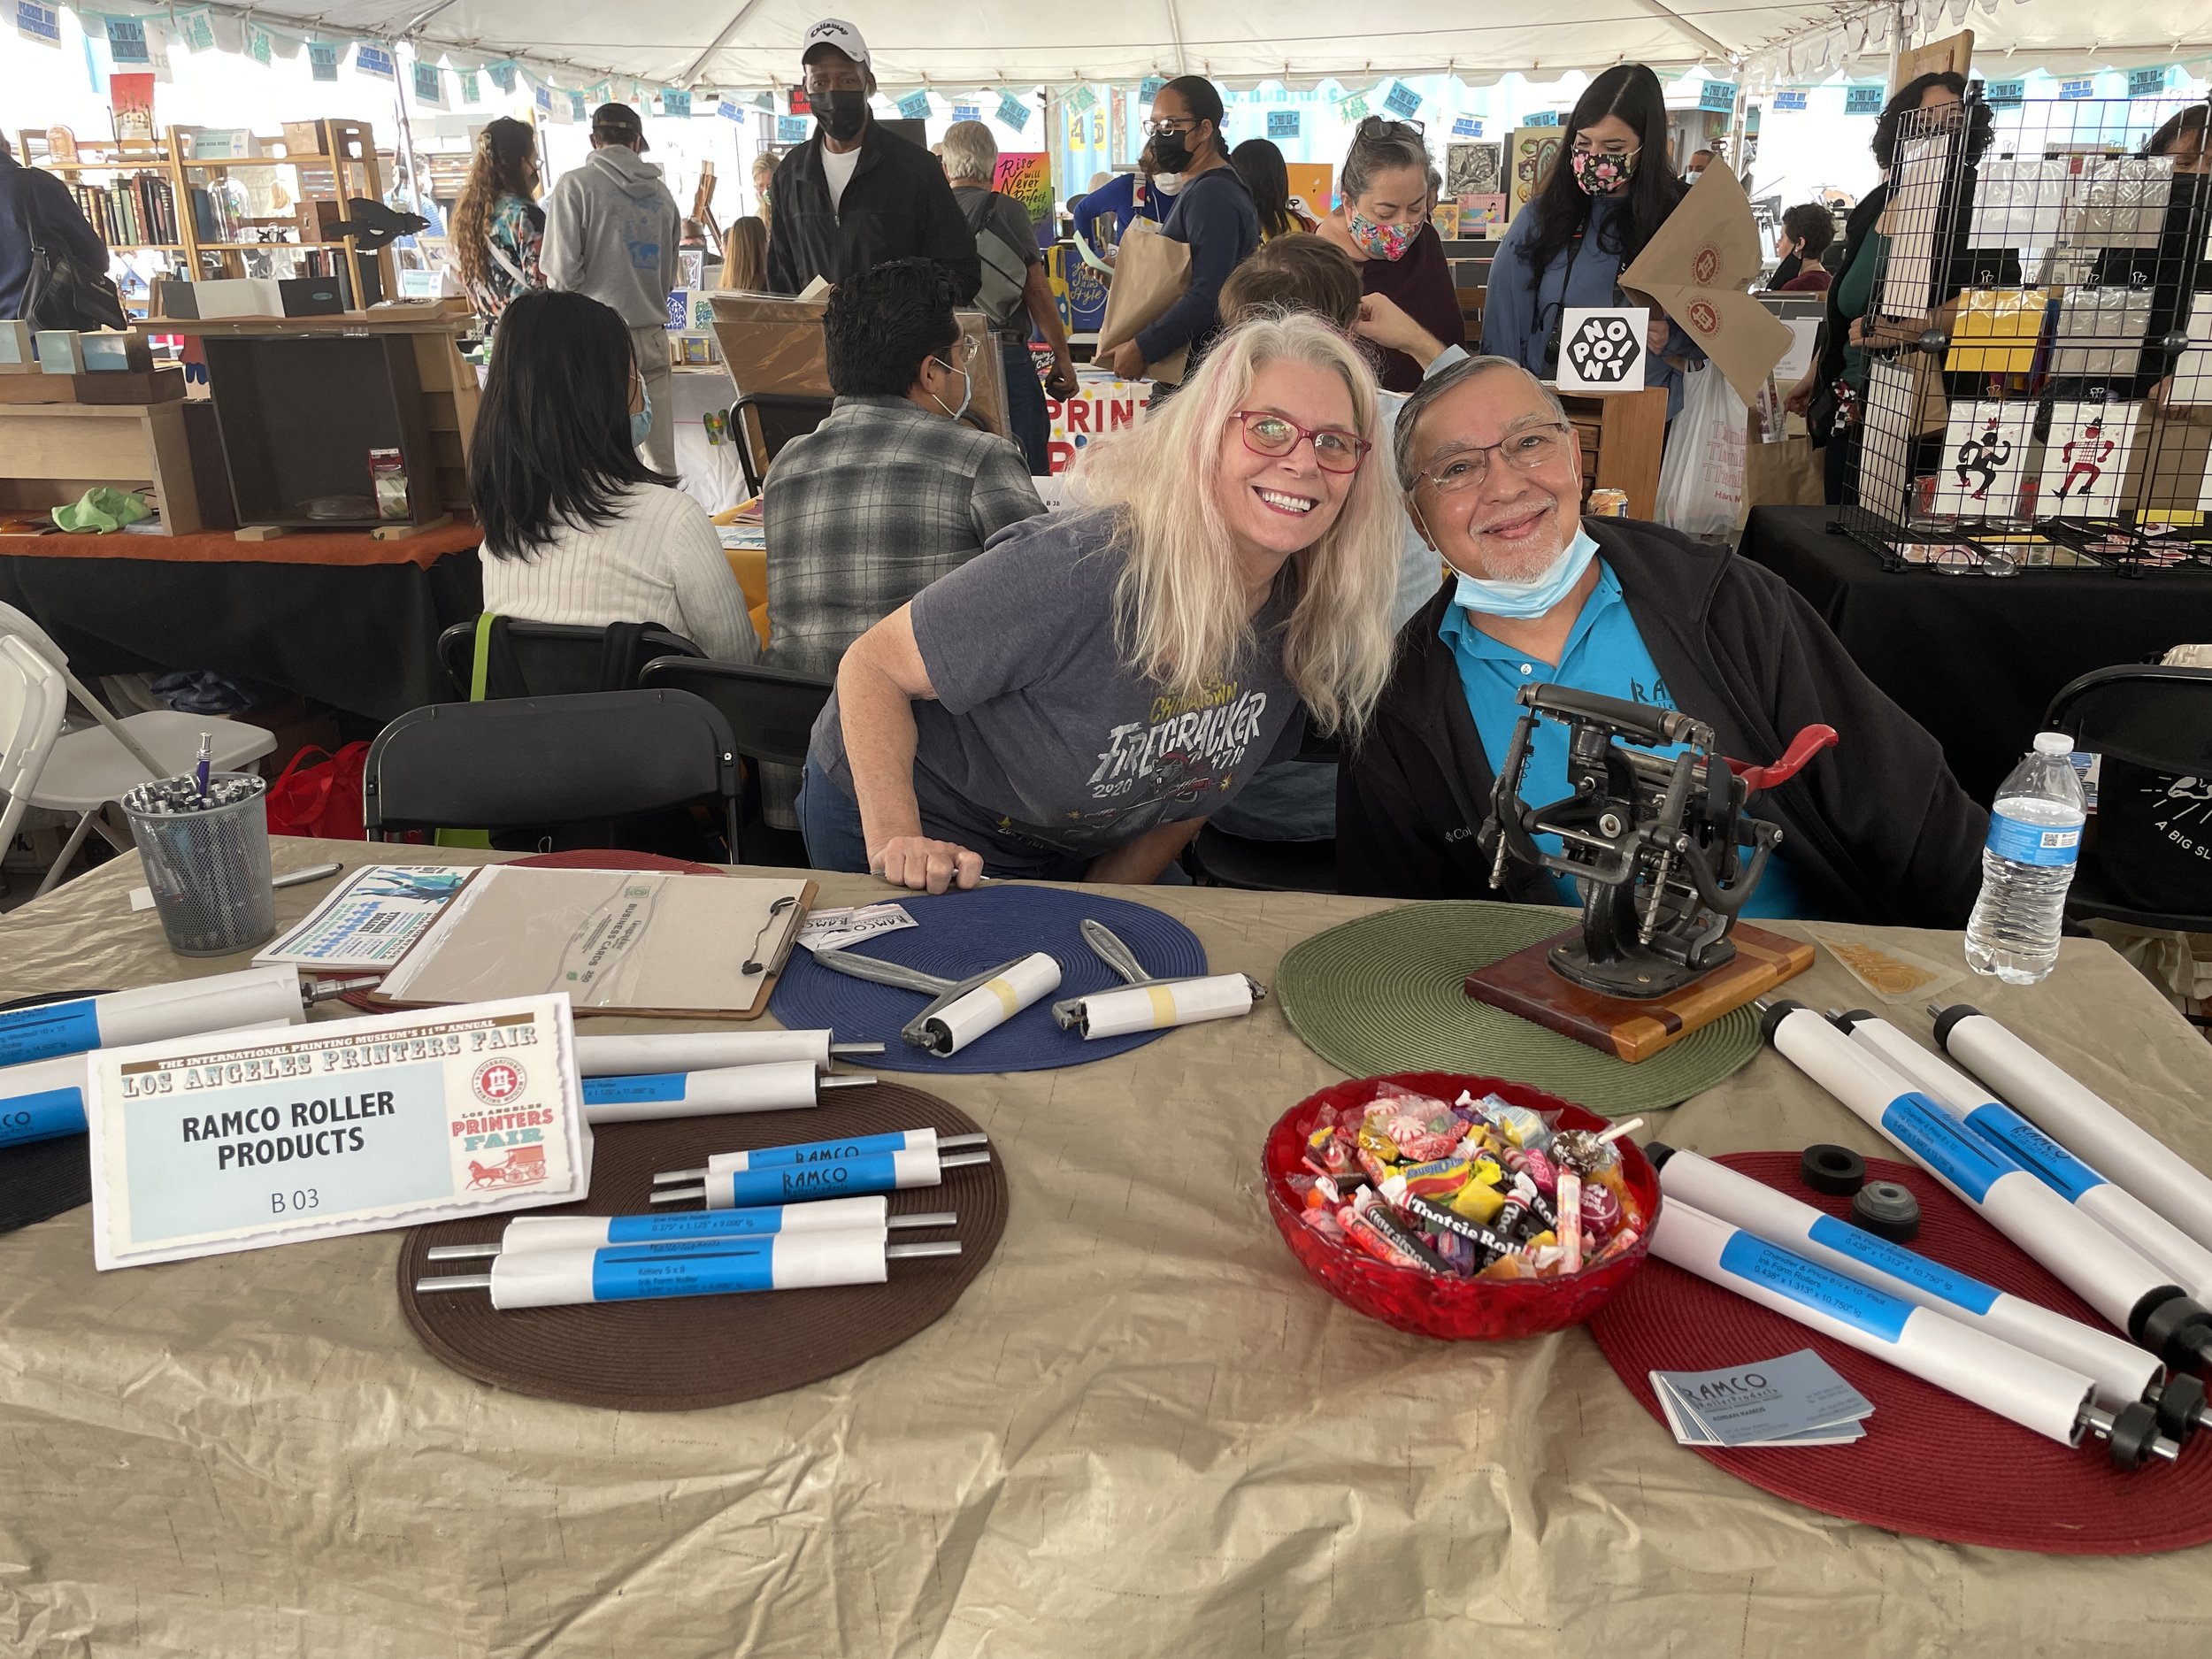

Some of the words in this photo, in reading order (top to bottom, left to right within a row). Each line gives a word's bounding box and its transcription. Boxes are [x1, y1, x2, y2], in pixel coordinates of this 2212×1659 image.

[810, 23, 849, 38] Callaway
[791, 103, 811, 114] SMOK
[999, 158, 1036, 179] Riso
[1024, 170, 1041, 179] will
[1001, 171, 1040, 195] Never
[1070, 288, 1102, 305] Style
[1583, 319, 1628, 343] NO
[1583, 359, 1624, 380] NT
[1086, 689, 1267, 787] FIRECRACKER
[1092, 779, 1133, 798] 2020
[2154, 821, 2168, 831] A
[2168, 830, 2193, 849] BIG
[608, 903, 637, 940] BUSINESS
[806, 917, 848, 928] RAMC
[588, 941, 611, 966] CARDS
[158, 1060, 184, 1069] THE
[187, 1046, 288, 1067] INTERNATIONAL
[291, 1038, 353, 1052] PRINTING
[355, 1029, 418, 1046] MUSEUM'S
[448, 1019, 495, 1032] ANNUAL
[121, 1072, 173, 1098] LOS
[184, 1054, 311, 1090] ANGELES
[322, 1034, 460, 1071] PRINTERS
[471, 1025, 538, 1053] FAIR
[181, 1106, 280, 1143] RAMCO
[291, 1090, 396, 1129] ROLLER
[452, 1108, 555, 1138] PRINTERS
[461, 1110, 483, 1119] LOS
[488, 1102, 542, 1116] ANGELES
[218, 1126, 365, 1171] PRODUCTS
[465, 1127, 545, 1152] FAIR
[796, 1146, 859, 1164] RAMCO
[782, 1167, 848, 1196] RAMCO
[271, 1193, 286, 1214] B
[293, 1188, 320, 1211] 03
[1413, 1198, 1479, 1240] Tootsie
[1758, 1256, 1770, 1266] Ink
[1771, 1262, 1792, 1275] Form
[1793, 1271, 1822, 1288] Rollers
[1845, 1238, 1871, 1252] 0.438"
[1879, 1252, 1905, 1267] 1.313"
[1913, 1267, 1945, 1284] 10.750"
[1754, 1265, 1781, 1280] 0.438"
[1787, 1279, 1814, 1294] 1.313"
[1822, 1294, 1854, 1311] 10.750"
[1763, 1248, 1798, 1268] Chandler
[1808, 1267, 1828, 1281] Price
[1867, 1293, 1886, 1306] Pilot
[1675, 1373, 1768, 1409] RAMCO
